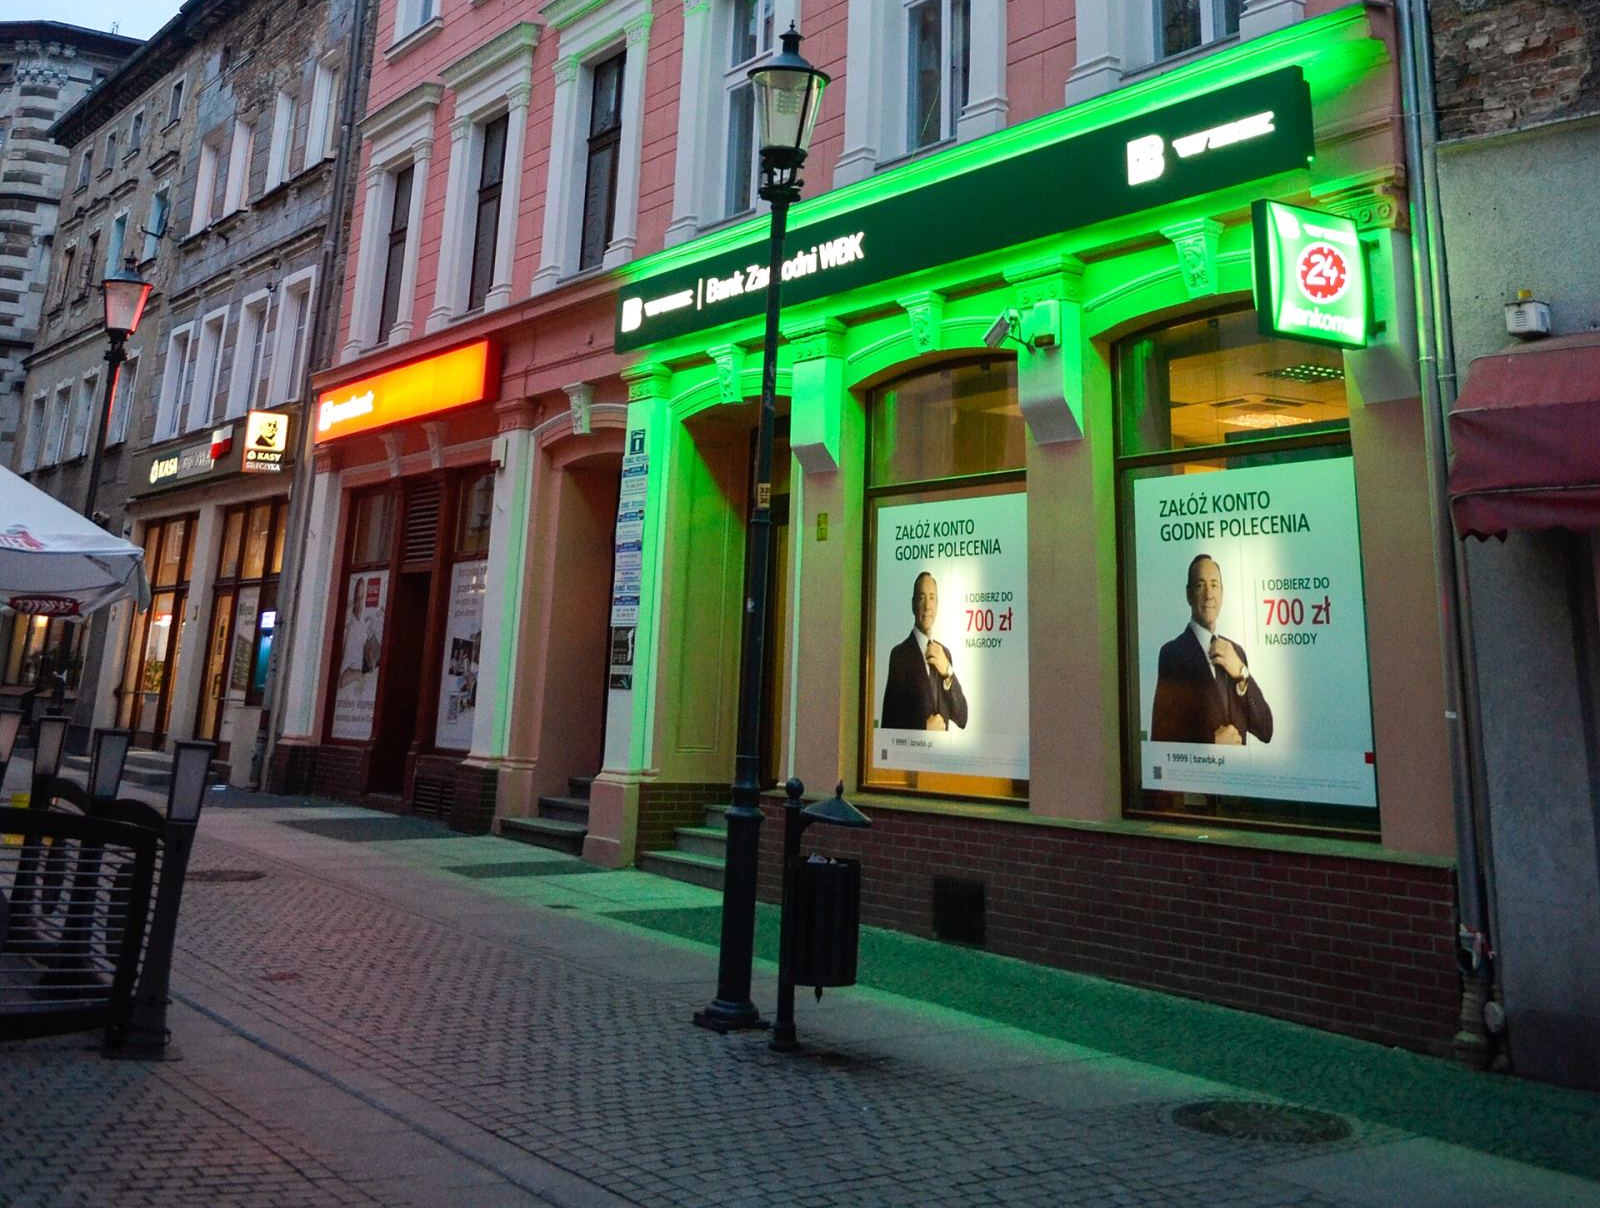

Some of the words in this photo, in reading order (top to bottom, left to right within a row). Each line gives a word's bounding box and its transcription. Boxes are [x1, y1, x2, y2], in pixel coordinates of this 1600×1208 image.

[705, 270, 744, 304] Bank
[818, 231, 865, 270] WBK
[1305, 253, 1339, 286] 24
[257, 452, 282, 462] KASY
[1158, 491, 1209, 518] ZAŁÓŻ
[1211, 490, 1271, 514] KONTO
[895, 519, 931, 542] ZAŁÓŻ
[933, 518, 975, 539] KONTO
[1159, 520, 1215, 543] GODNE
[1219, 512, 1311, 538] POLECENIA
[895, 543, 935, 561] GODNE
[938, 538, 1002, 559] POLECENIA
[1267, 577, 1311, 591] ODBIERZ
[1313, 576, 1330, 590] DO
[969, 591, 1000, 603] ODBIERZ
[1001, 591, 1013, 603] DO
[965, 608, 995, 632] 700
[999, 606, 1013, 632] zł
[1263, 597, 1304, 626] 700
[1311, 595, 1332, 625] zł
[965, 637, 1003, 649] NAGRODY
[1264, 632, 1318, 646] NAGRODY
[1192, 753, 1226, 767] bzwbk.pl
